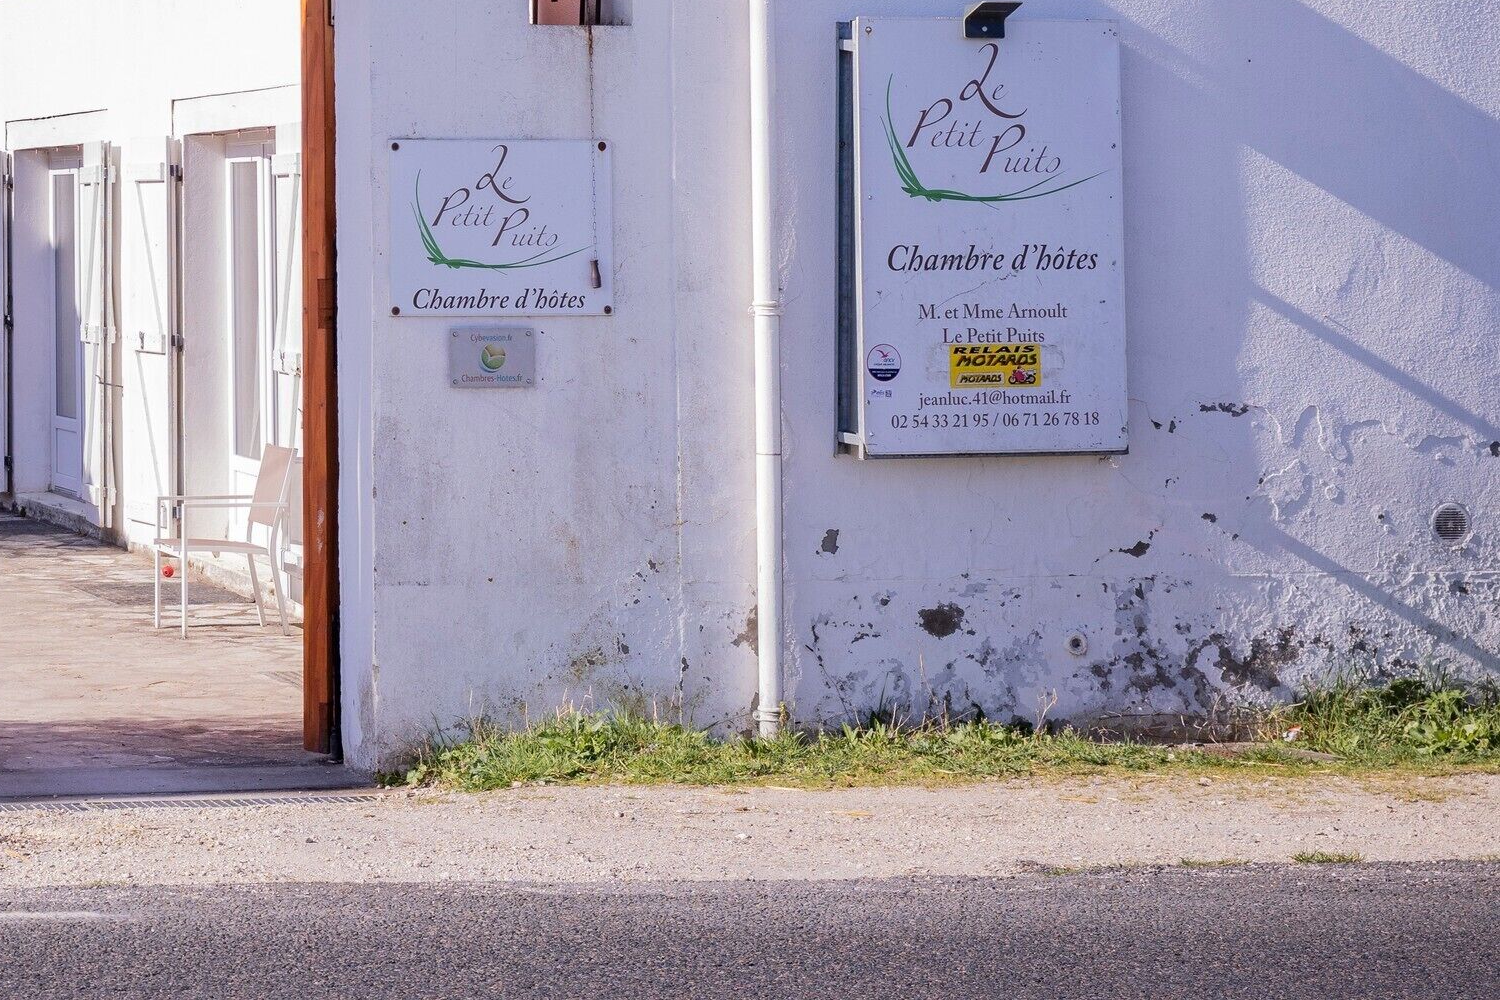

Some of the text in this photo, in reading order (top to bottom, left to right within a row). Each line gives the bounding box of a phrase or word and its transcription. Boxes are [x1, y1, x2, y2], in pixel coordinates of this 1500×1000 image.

[959, 43, 1028, 118] Le
[906, 98, 984, 149] Petit
[979, 124, 1061, 174] Puits
[475, 144, 531, 204] Le
[432, 187, 497, 227] Petit
[491, 207, 558, 247] Puits
[887, 244, 1098, 271] Chambre d’hôtes
[412, 288, 586, 310] Chambre d’hôtes
[918, 303, 1068, 319] M. et Mme Arnoult
[942, 327, 1045, 344] Le Petit Puits
[953, 345, 1035, 354] RELAIS
[956, 354, 1037, 367] MOTARDS
[960, 374, 1002, 383] MOTARDS
[918, 390, 1071, 410] jeanluc.41@hotmail.fr
[891, 411, 1100, 429] 02 54 33 21 95 / 06 71 26 78 18
